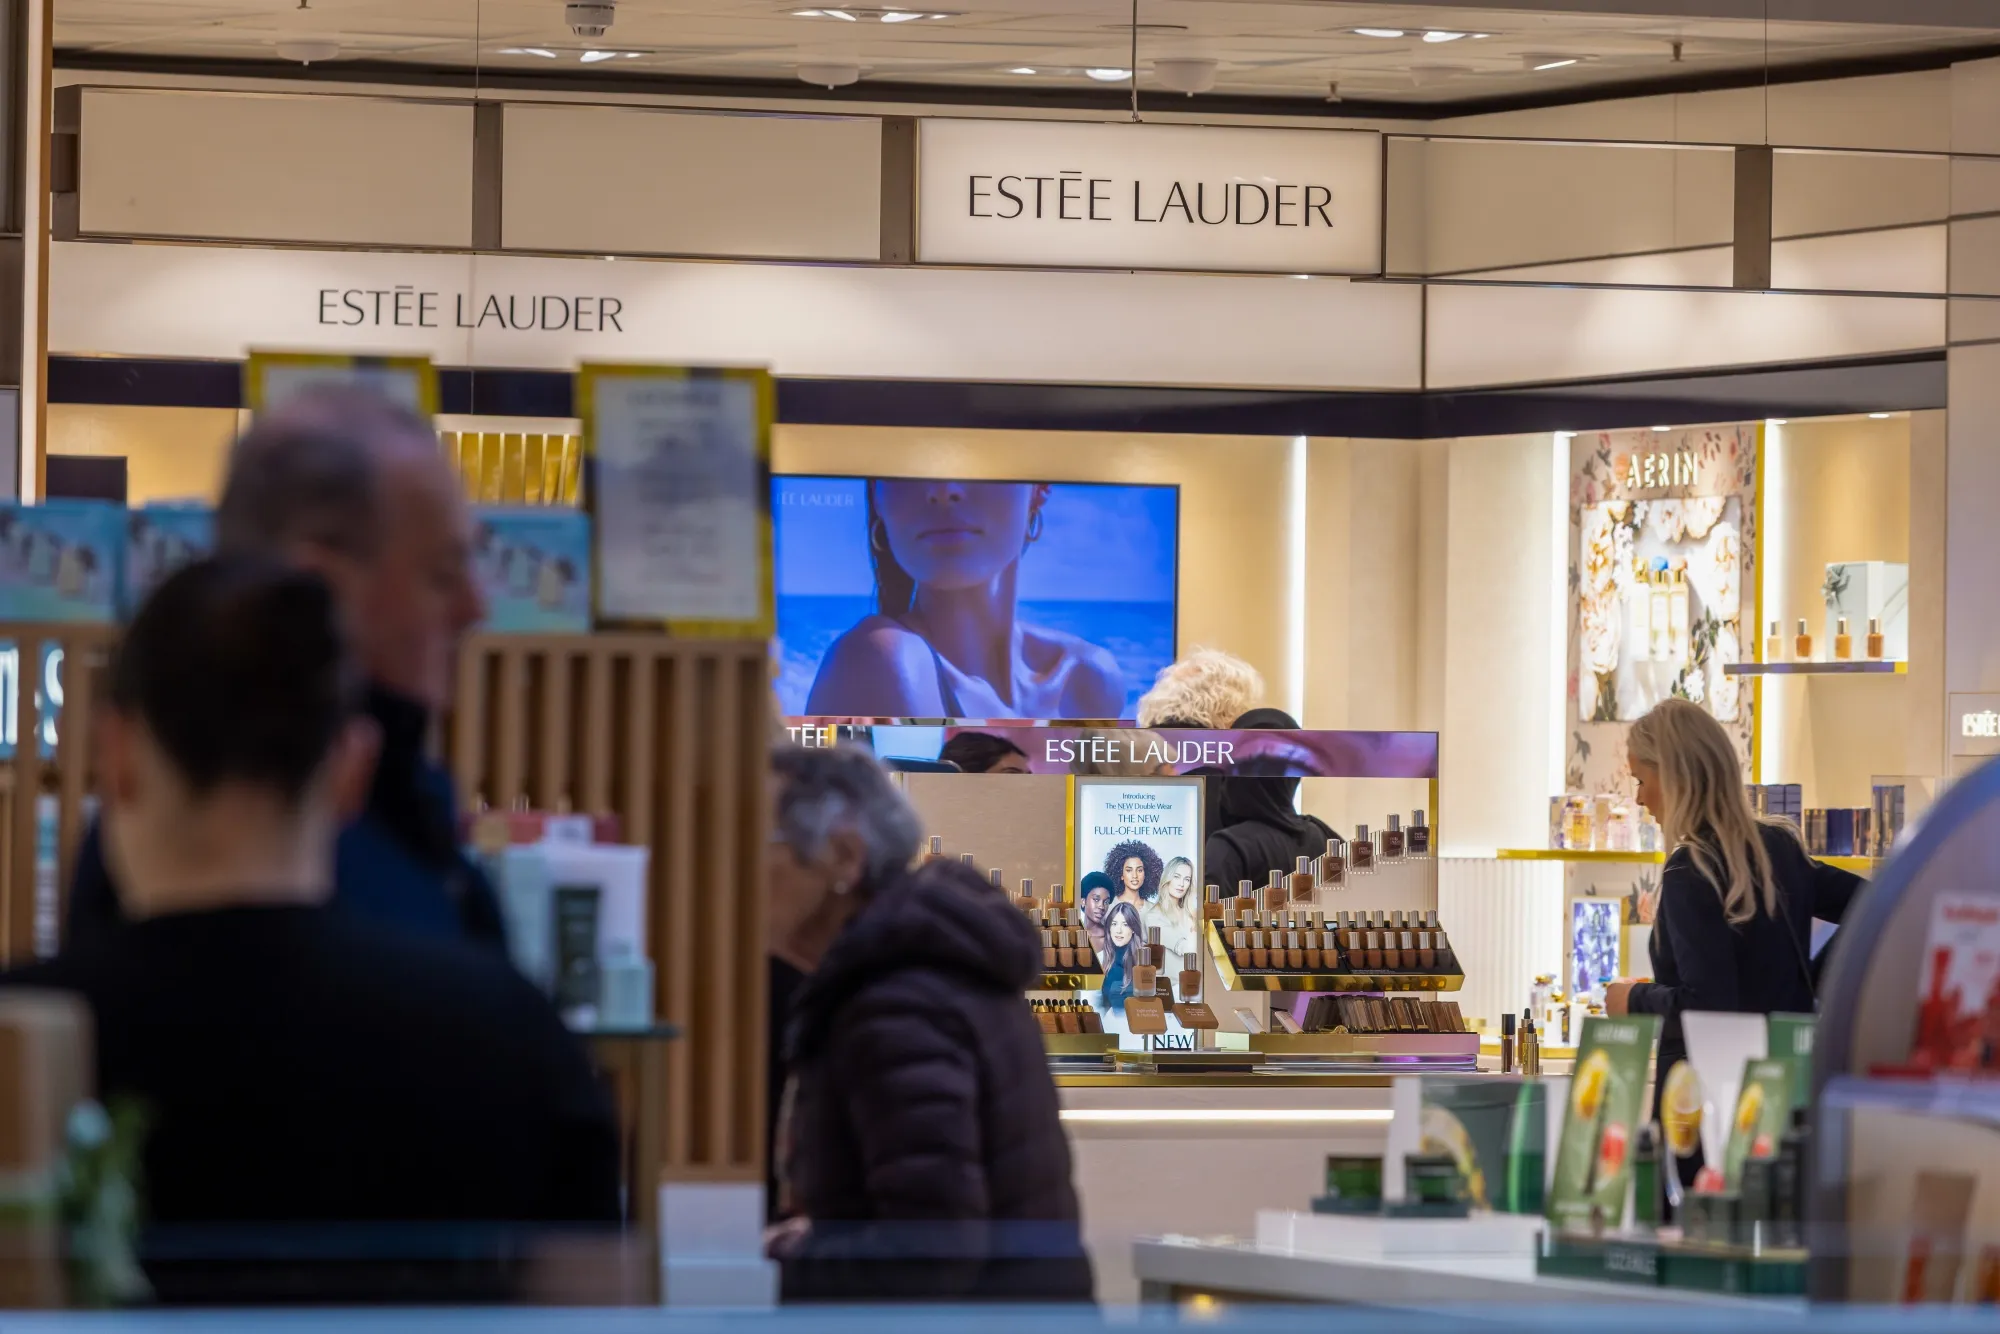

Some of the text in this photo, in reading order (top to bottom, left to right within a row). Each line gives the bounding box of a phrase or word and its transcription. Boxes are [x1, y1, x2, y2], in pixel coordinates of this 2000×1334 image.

[969, 170, 1334, 228] ESTĒE LAUDER
[318, 285, 624, 332] ESTĒE LAUDER
[1626, 451, 1699, 488] AERIN
[1045, 736, 1235, 764] ESTĒE LAUDER
[1122, 793, 1156, 801] Introducing
[1118, 814, 1160, 823] THE NEW
[1094, 826, 1183, 835] FULL-OF-LIFE MATTE
[1155, 1034, 1194, 1048] NEW
